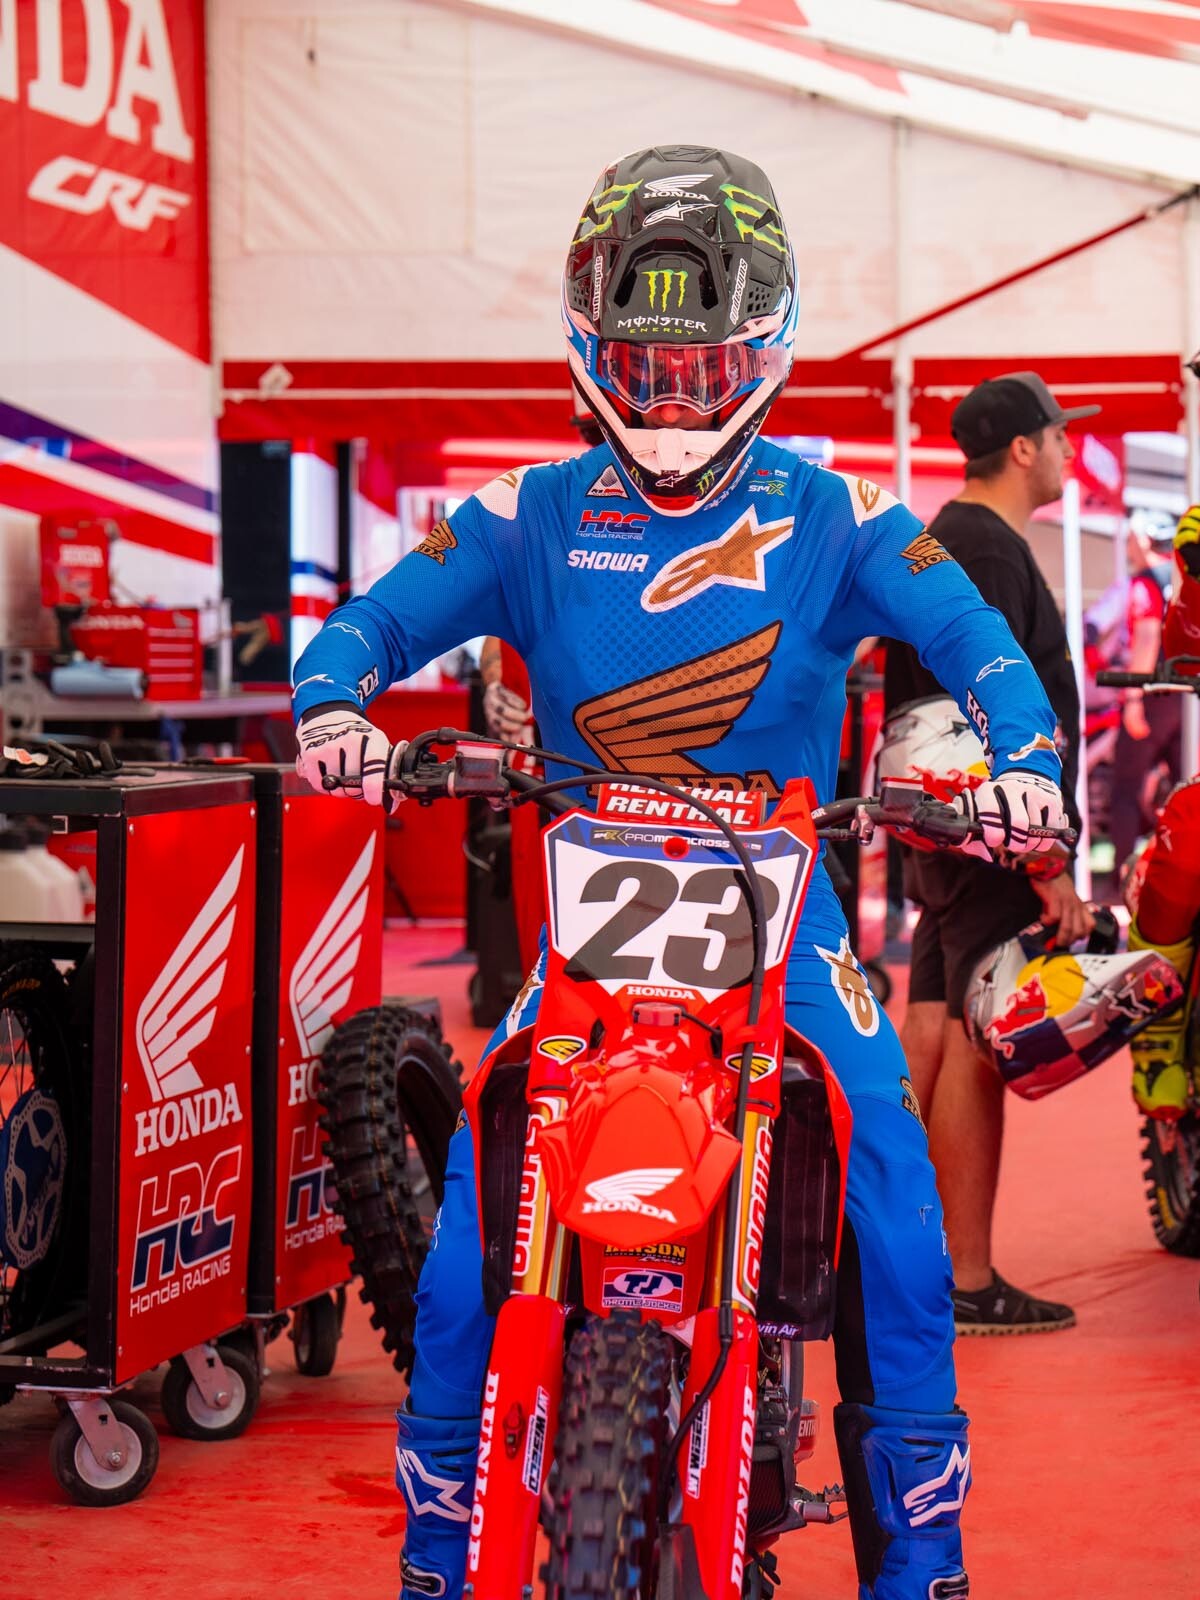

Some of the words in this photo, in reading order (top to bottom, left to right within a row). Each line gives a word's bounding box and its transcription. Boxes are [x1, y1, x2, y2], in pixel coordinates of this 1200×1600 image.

[28, 156, 190, 231] CRF
[644, 190, 709, 201] HONDA
[617, 315, 708, 332] MONSTER
[629, 327, 694, 336] ENERGY
[585, 338, 593, 371] OAKLEY
[748, 481, 785, 497] SMX
[579, 509, 650, 534] HRC
[567, 549, 650, 573] SHOWA
[606, 795, 751, 825] RENTHAL
[563, 860, 780, 990] 23
[627, 985, 697, 1000] HONDA
[134, 1082, 243, 1157] HONDA
[130, 1144, 242, 1293] HRC
[582, 1199, 678, 1223] HONDA
[284, 1227, 320, 1252] Honda
[130, 1279, 180, 1317] Honda
[182, 1254, 231, 1294] RACING
[780, 1324, 799, 1336] Air
[529, 1413, 548, 1494] WISECO
[467, 1370, 499, 1572] DUNLOP
[729, 1385, 757, 1598] DUNLOP
